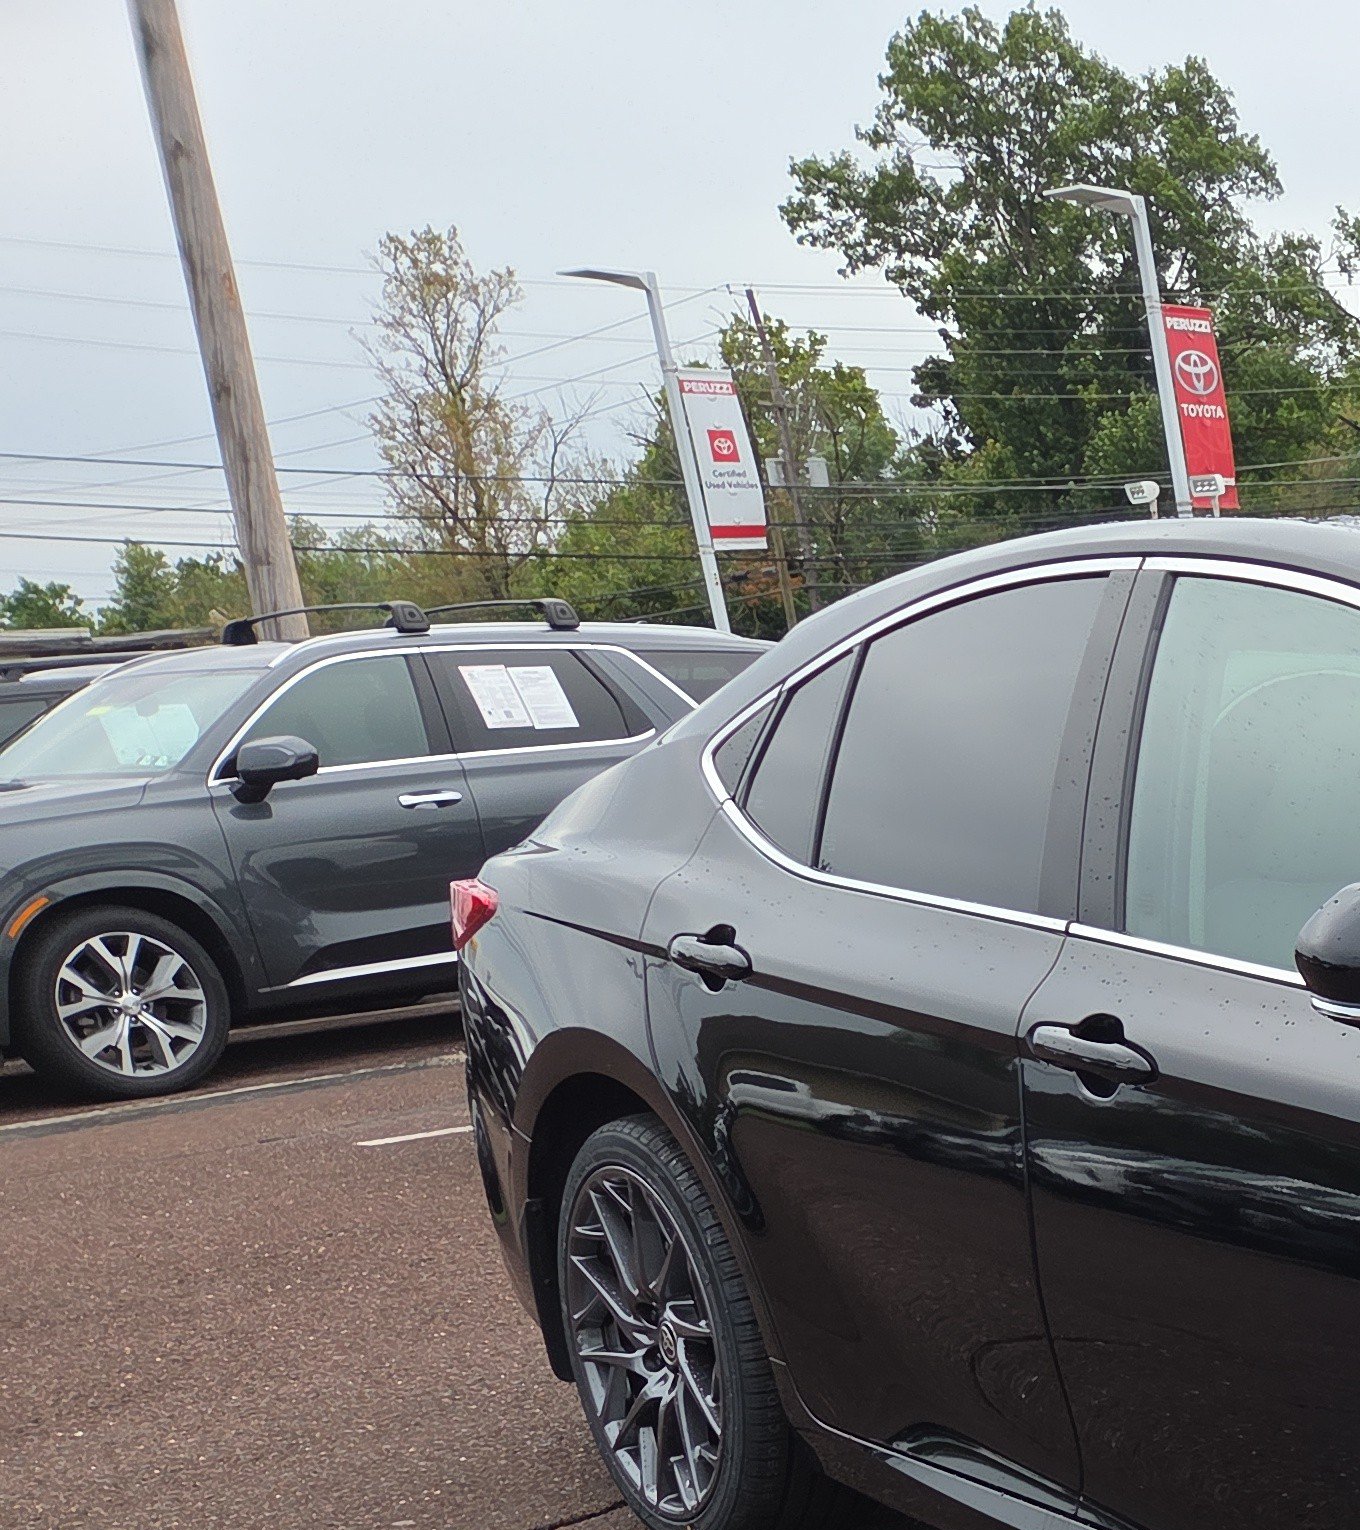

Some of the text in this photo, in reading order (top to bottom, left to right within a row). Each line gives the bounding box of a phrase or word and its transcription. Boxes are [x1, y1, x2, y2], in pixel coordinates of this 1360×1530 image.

[1166, 316, 1212, 333] PERUZZI
[683, 381, 733, 395] PERUZZI
[1181, 403, 1225, 419] TOYOTA
[705, 480, 726, 490] Used
